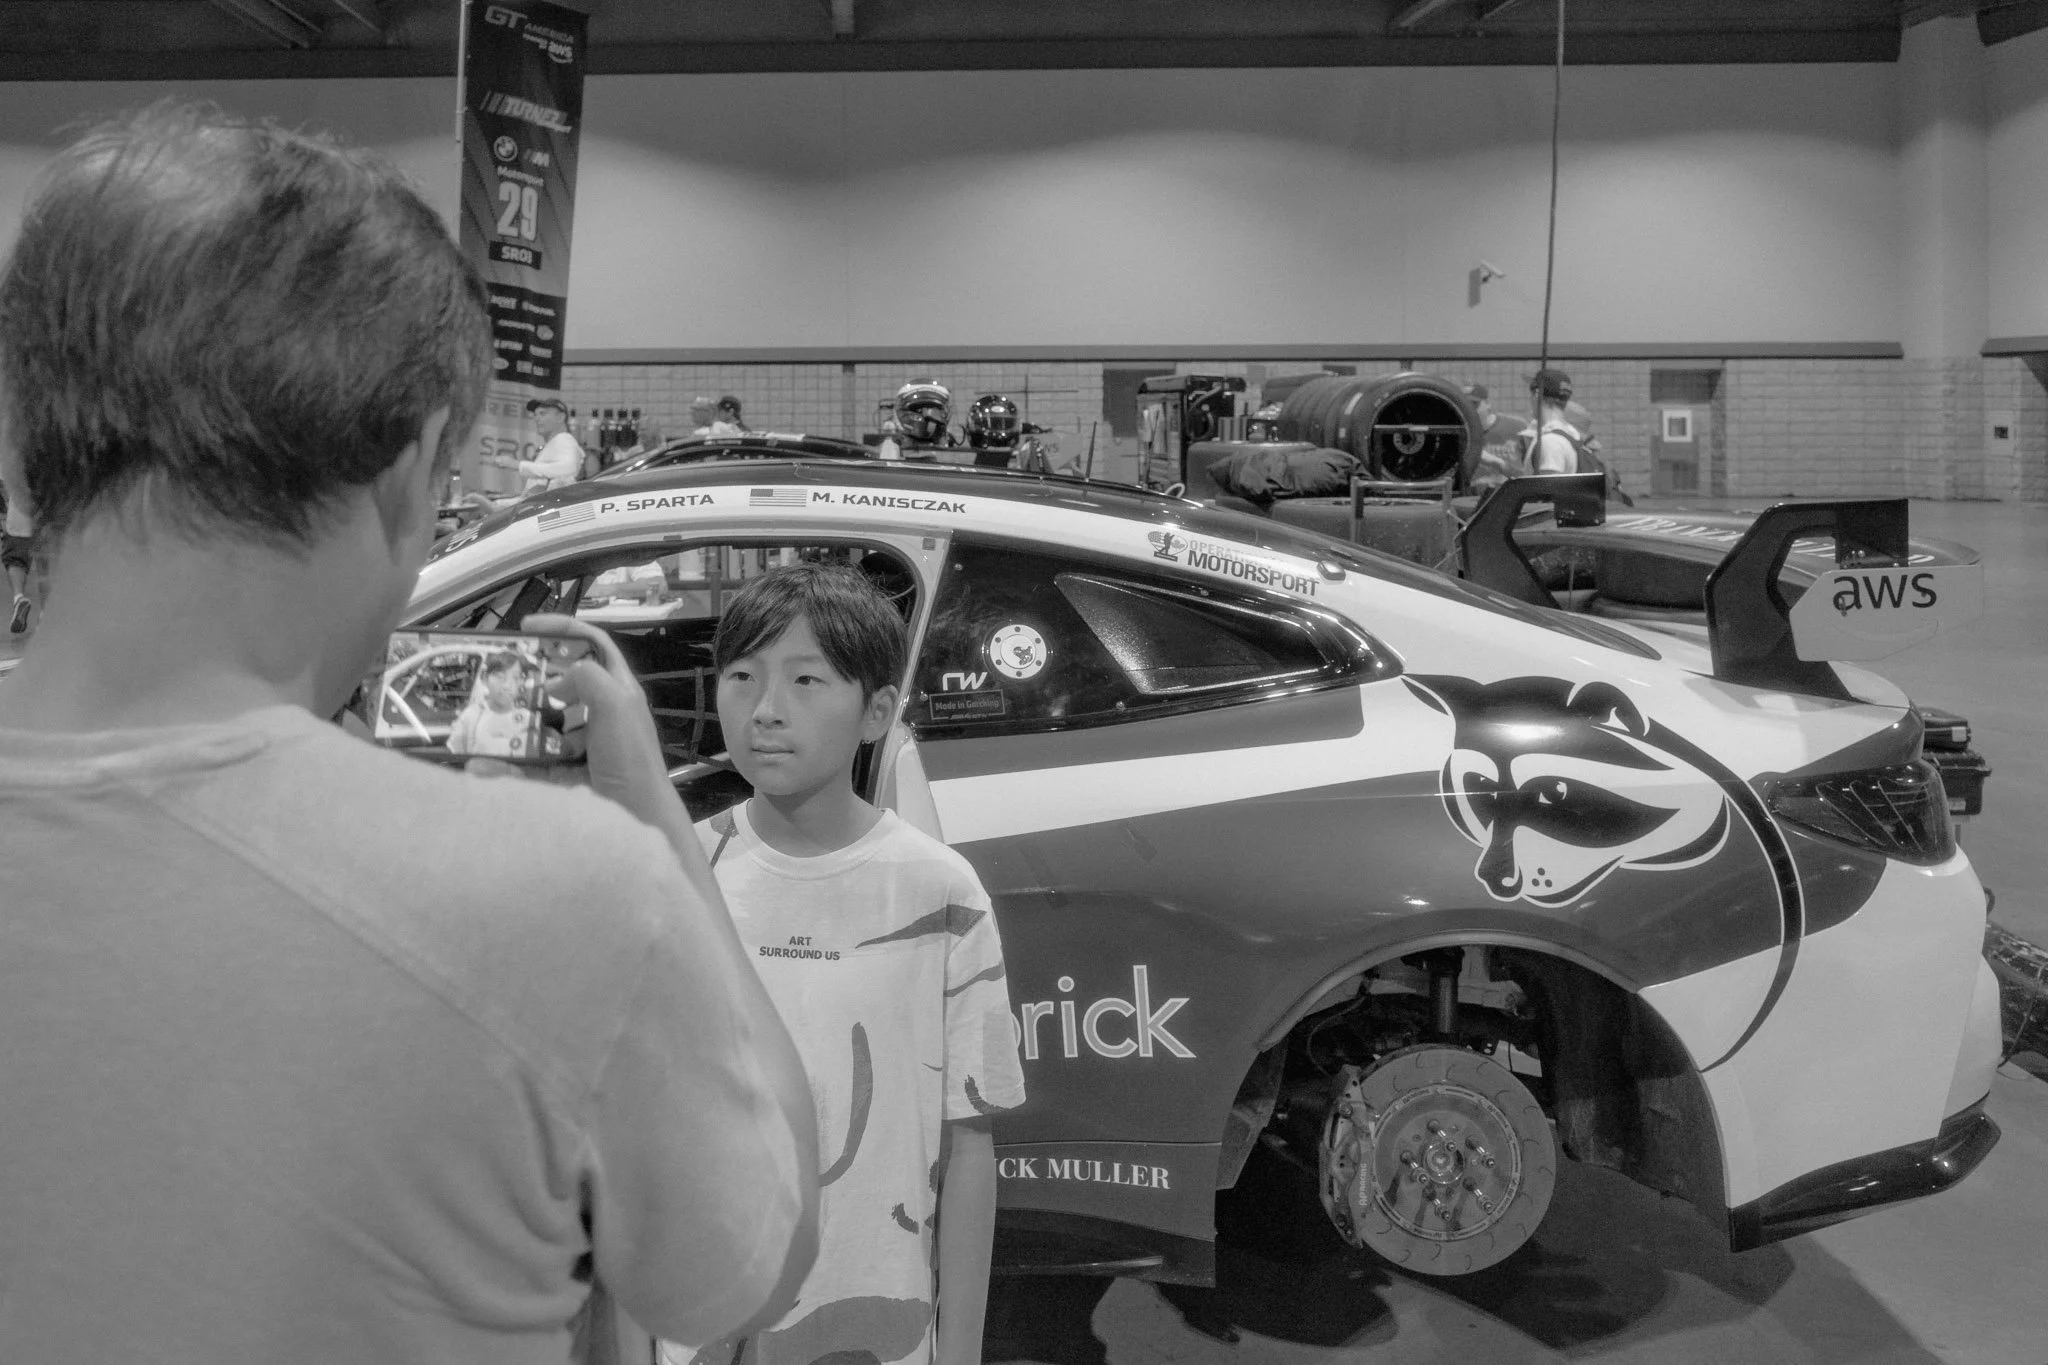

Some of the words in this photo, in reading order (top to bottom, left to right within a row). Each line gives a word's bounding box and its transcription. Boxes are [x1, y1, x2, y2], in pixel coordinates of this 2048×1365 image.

[485, 5, 528, 28] GT
[497, 181, 538, 241] 29
[600, 502, 619, 514] P.
[627, 494, 714, 512] SPARTA
[812, 492, 835, 504] M.
[843, 494, 966, 513] KANISCZAK
[1188, 550, 1320, 596] MOTORSPORT
[1833, 573, 1937, 611] aws
[935, 702, 957, 711] Made
[957, 701, 966, 709] in
[789, 936, 812, 946] ART
[759, 946, 822, 959] SURROUND
[825, 951, 840, 960] US
[1011, 964, 1197, 1061] rick
[995, 1157, 1040, 1179] CK
[1046, 1158, 1171, 1190] MULLER
